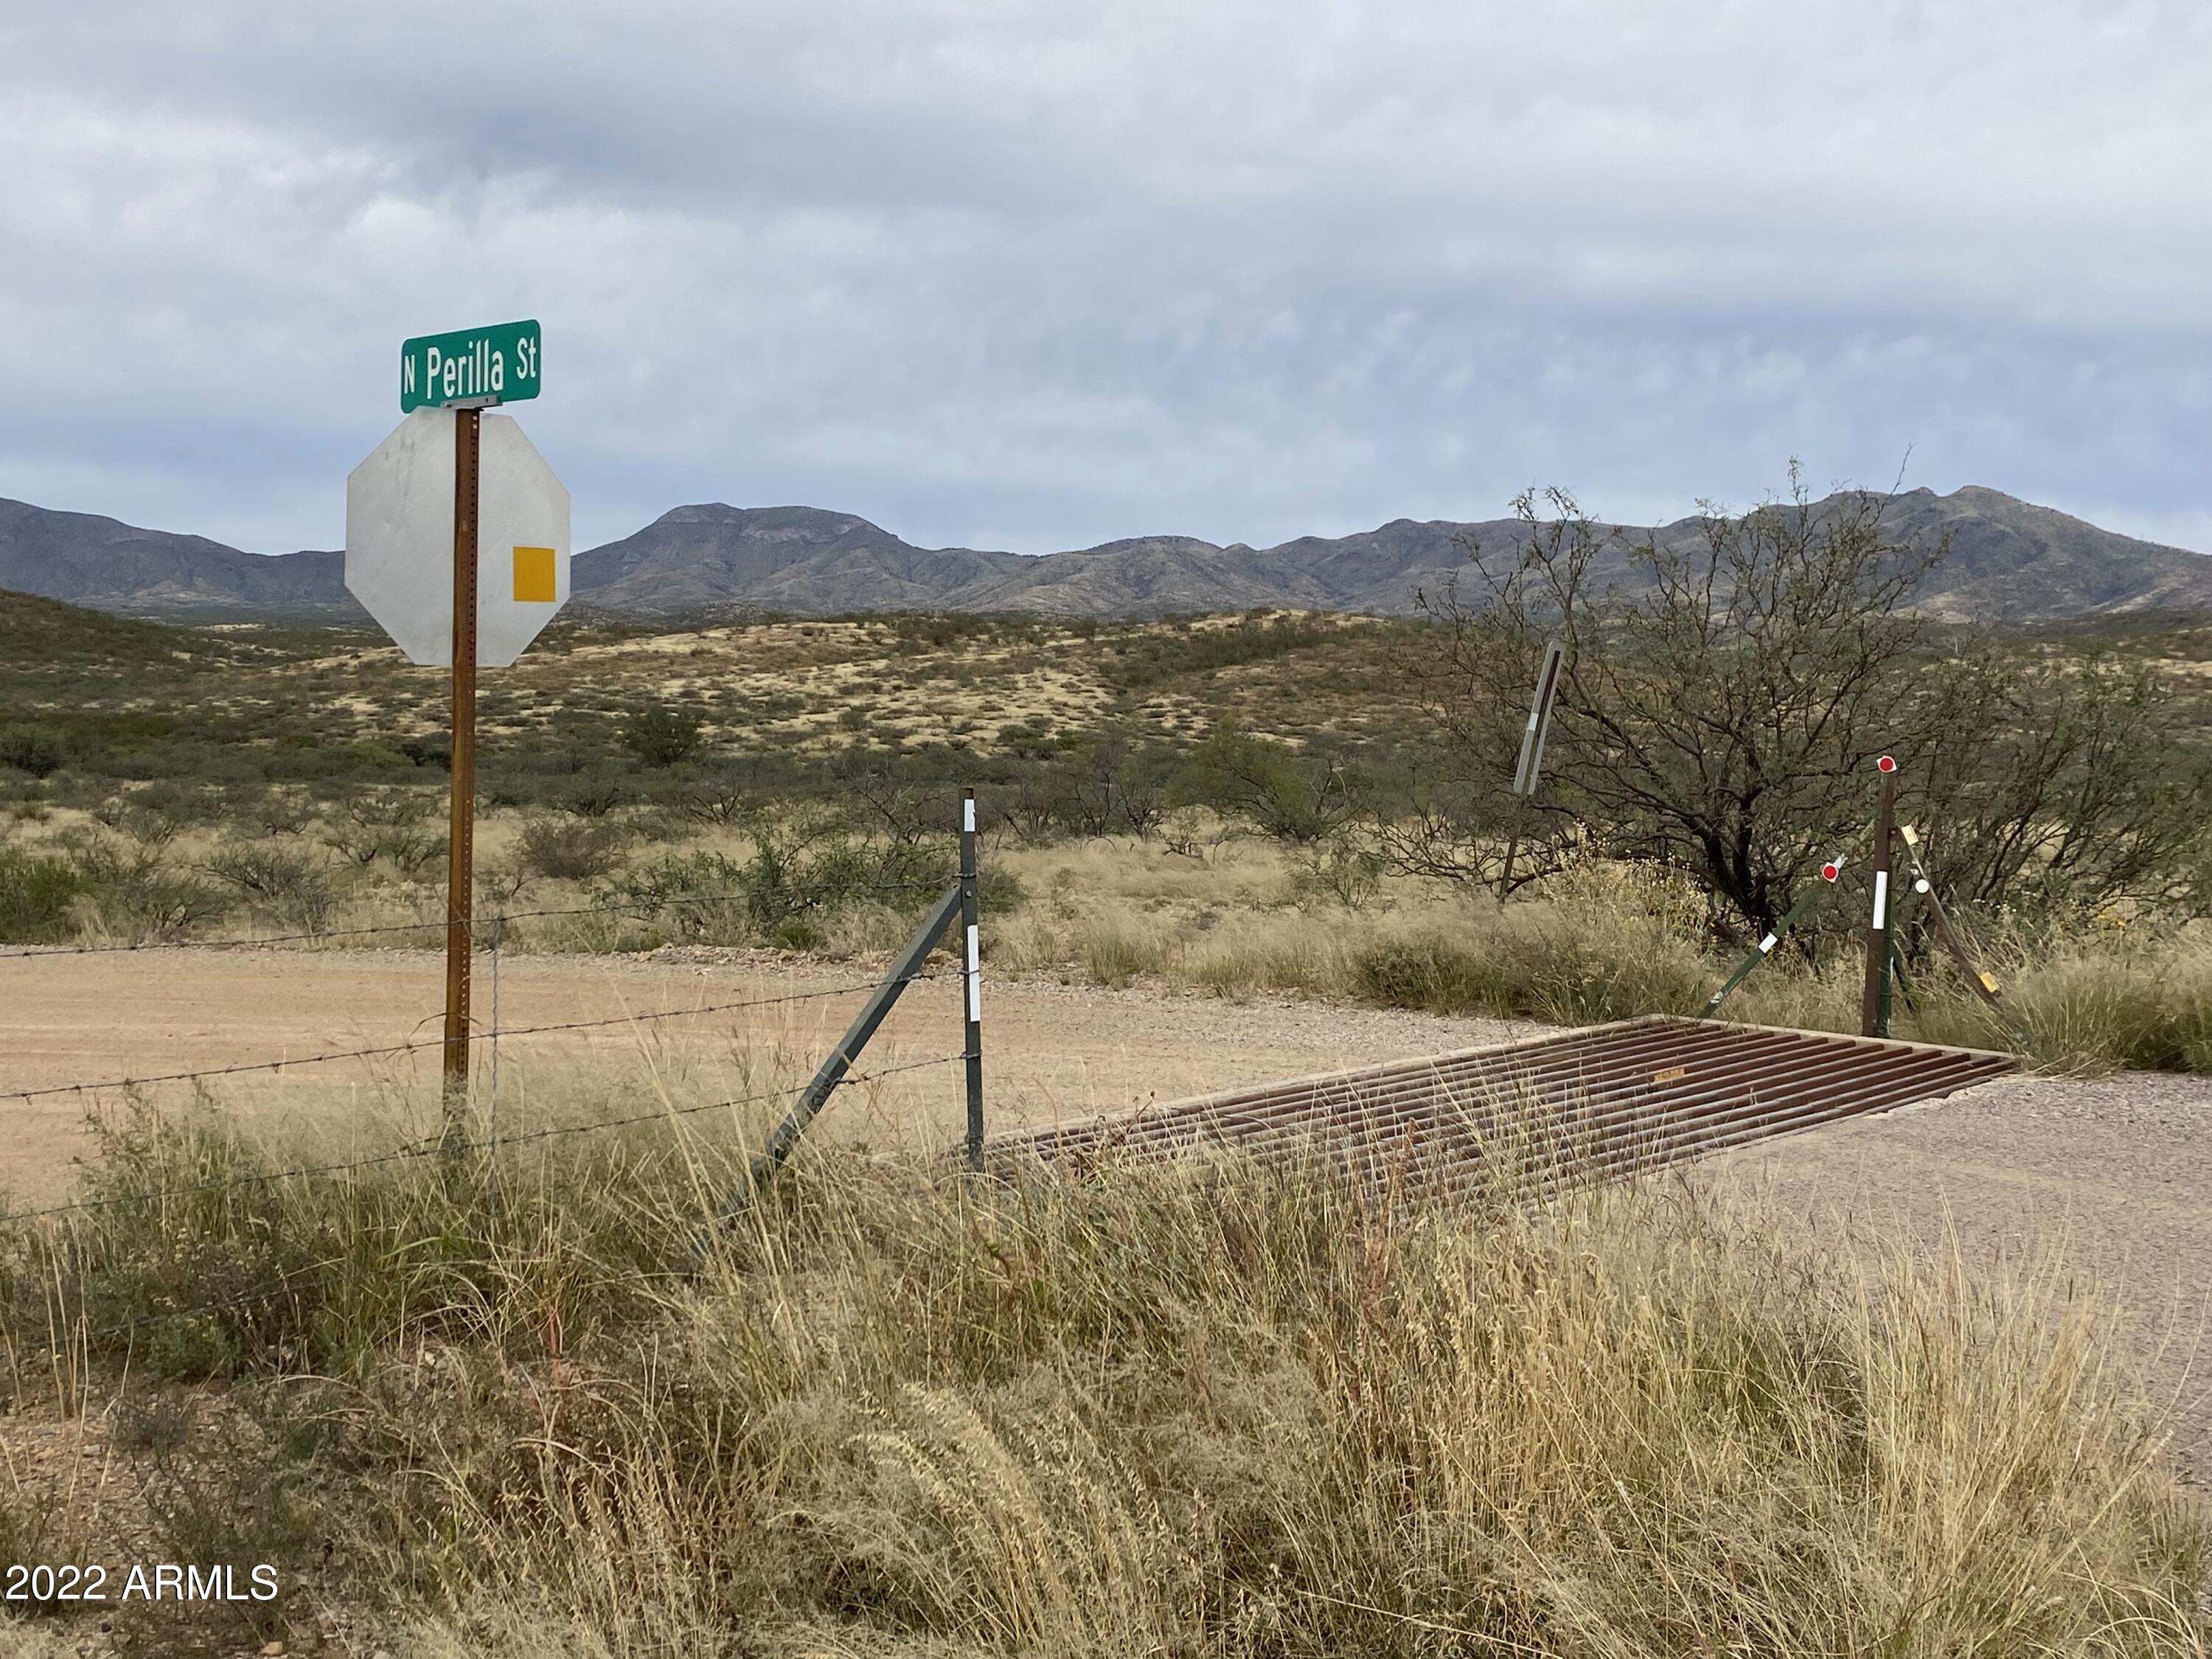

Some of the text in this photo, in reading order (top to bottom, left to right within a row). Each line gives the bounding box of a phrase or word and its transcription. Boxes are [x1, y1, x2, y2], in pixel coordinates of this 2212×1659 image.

[404, 336, 536, 399] N Perilla St
